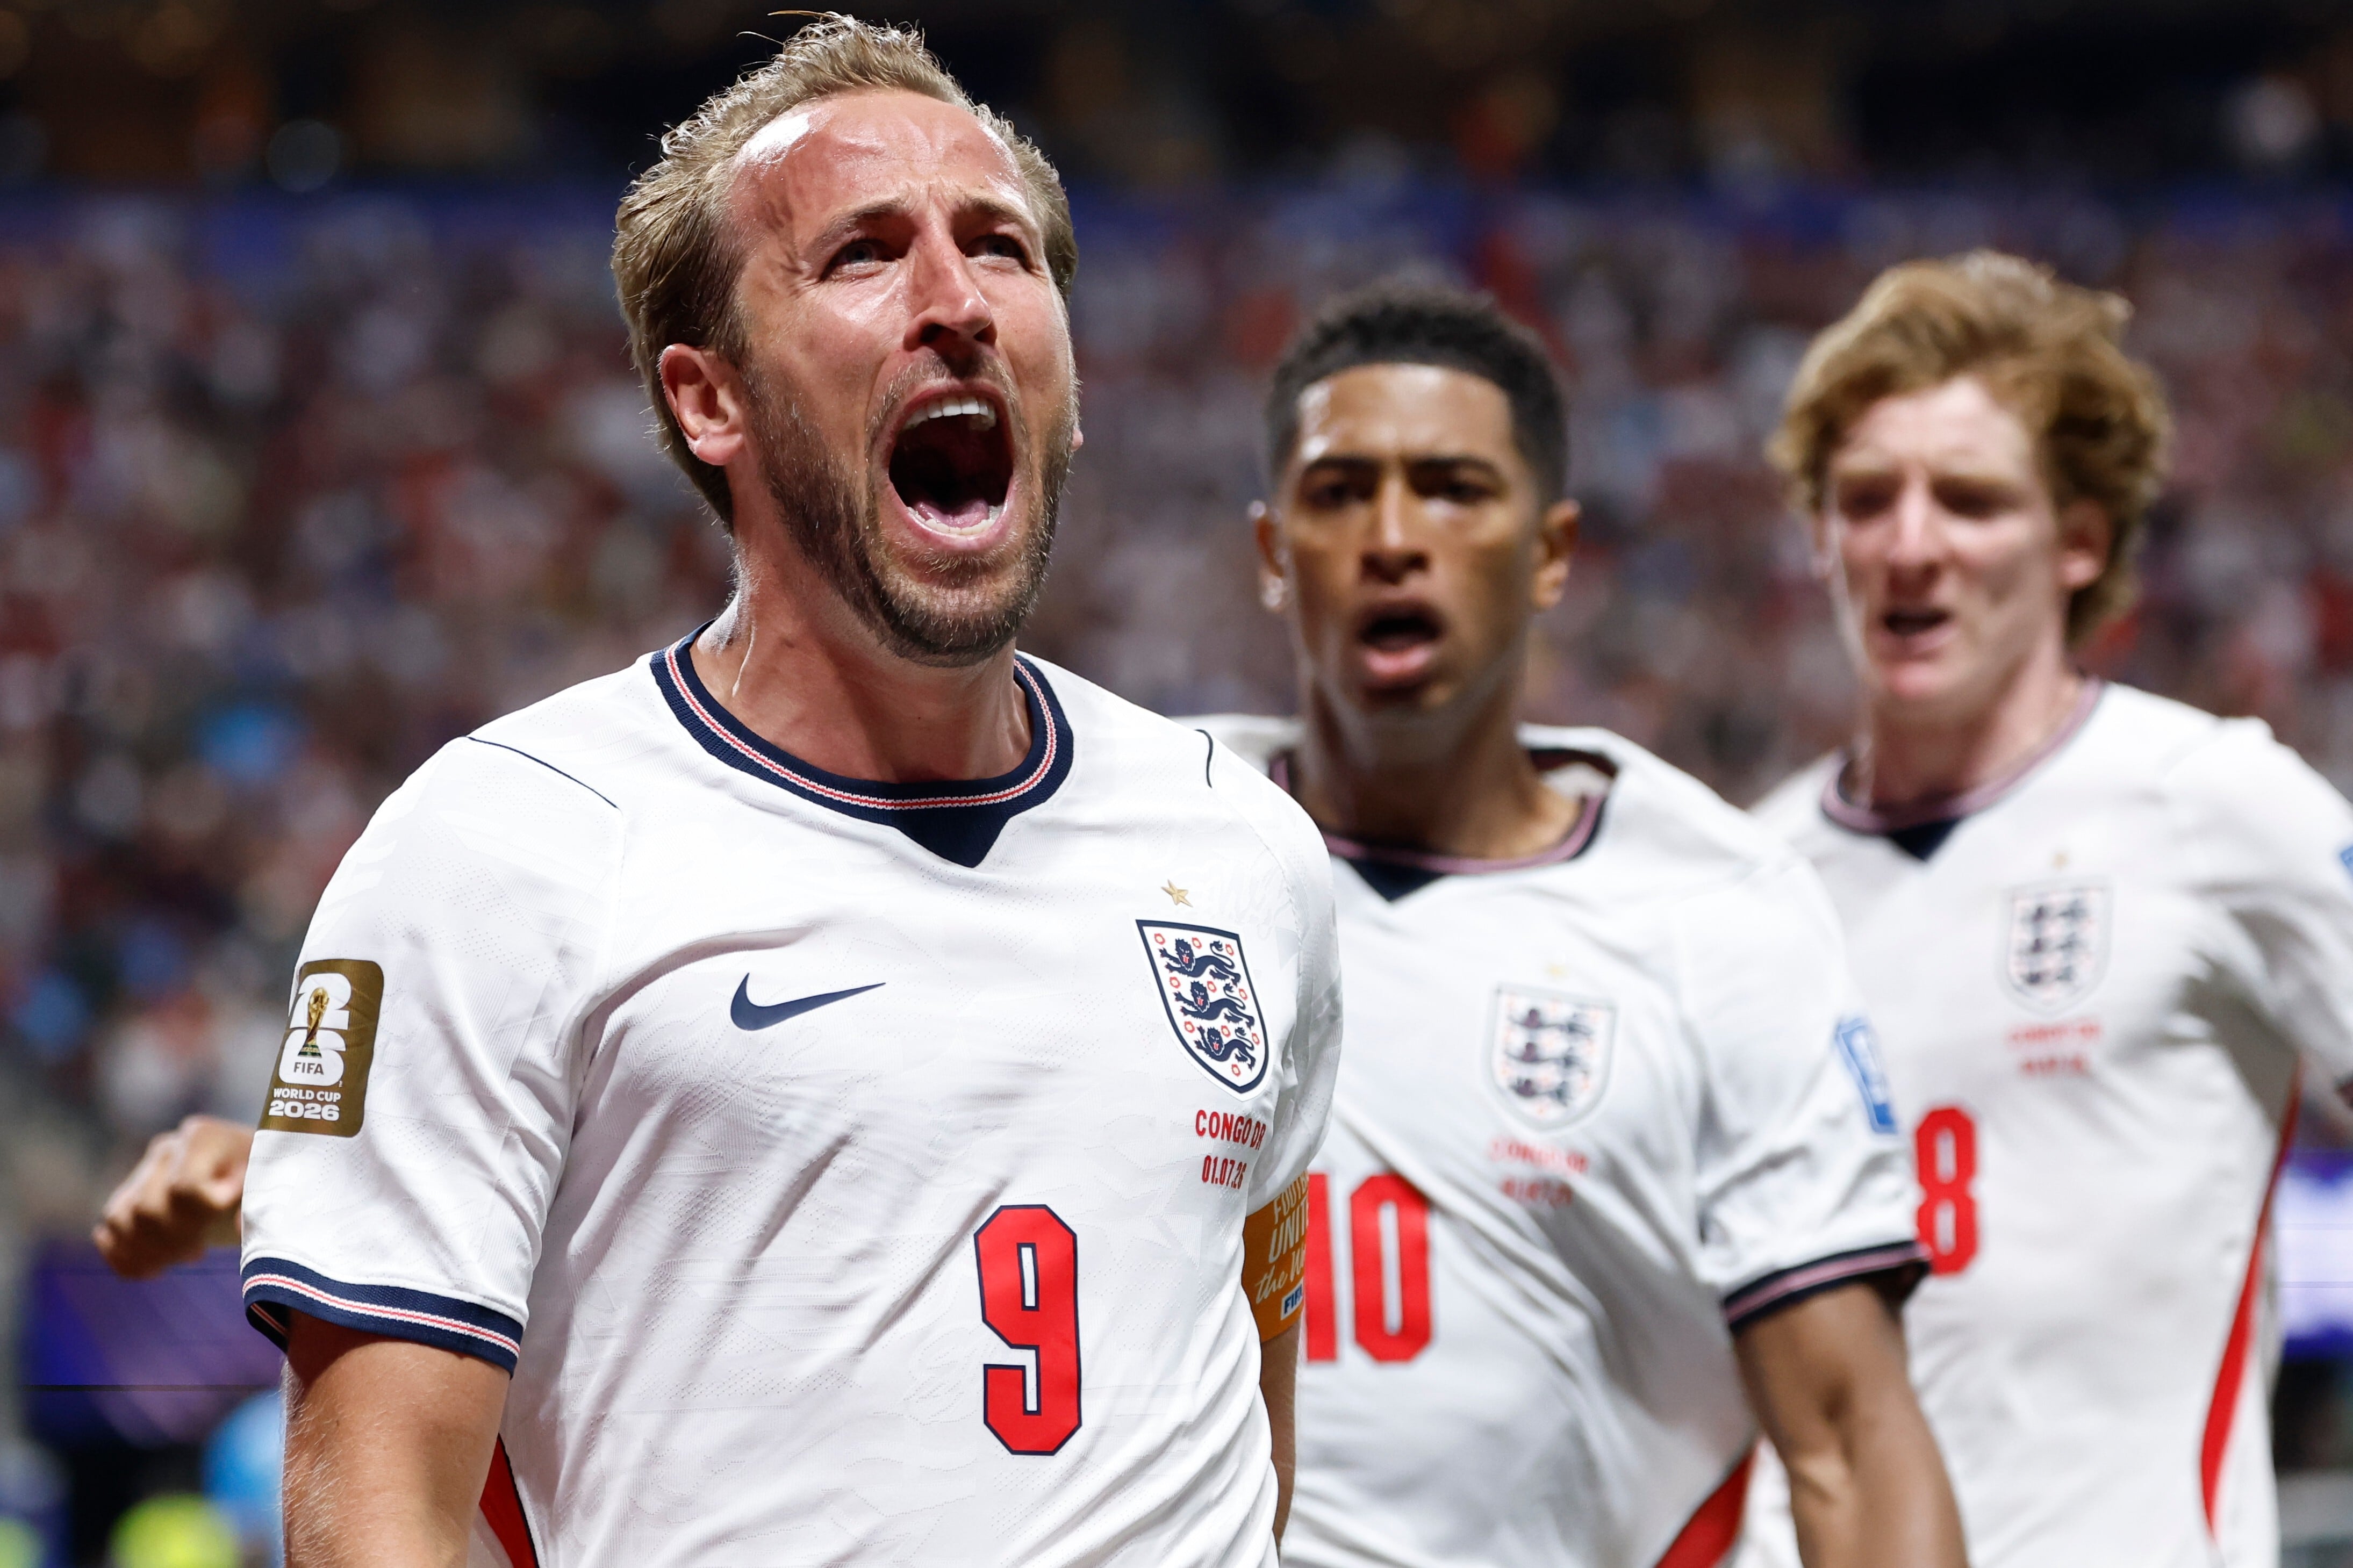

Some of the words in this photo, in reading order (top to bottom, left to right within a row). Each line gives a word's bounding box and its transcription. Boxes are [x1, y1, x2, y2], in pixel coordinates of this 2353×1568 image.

[293, 1062, 324, 1075] FIFA
[268, 1100, 340, 1122] 2026
[273, 1088, 314, 1101] WORLD
[316, 1090, 341, 1103] CUP
[1195, 1109, 1252, 1145] CONGO
[1250, 1121, 1267, 1150] DR
[1201, 1155, 1247, 1190] 01.07.26
[1255, 1264, 1288, 1305] the
[1305, 1174, 1432, 1362] 10
[973, 1204, 1082, 1456] 9
